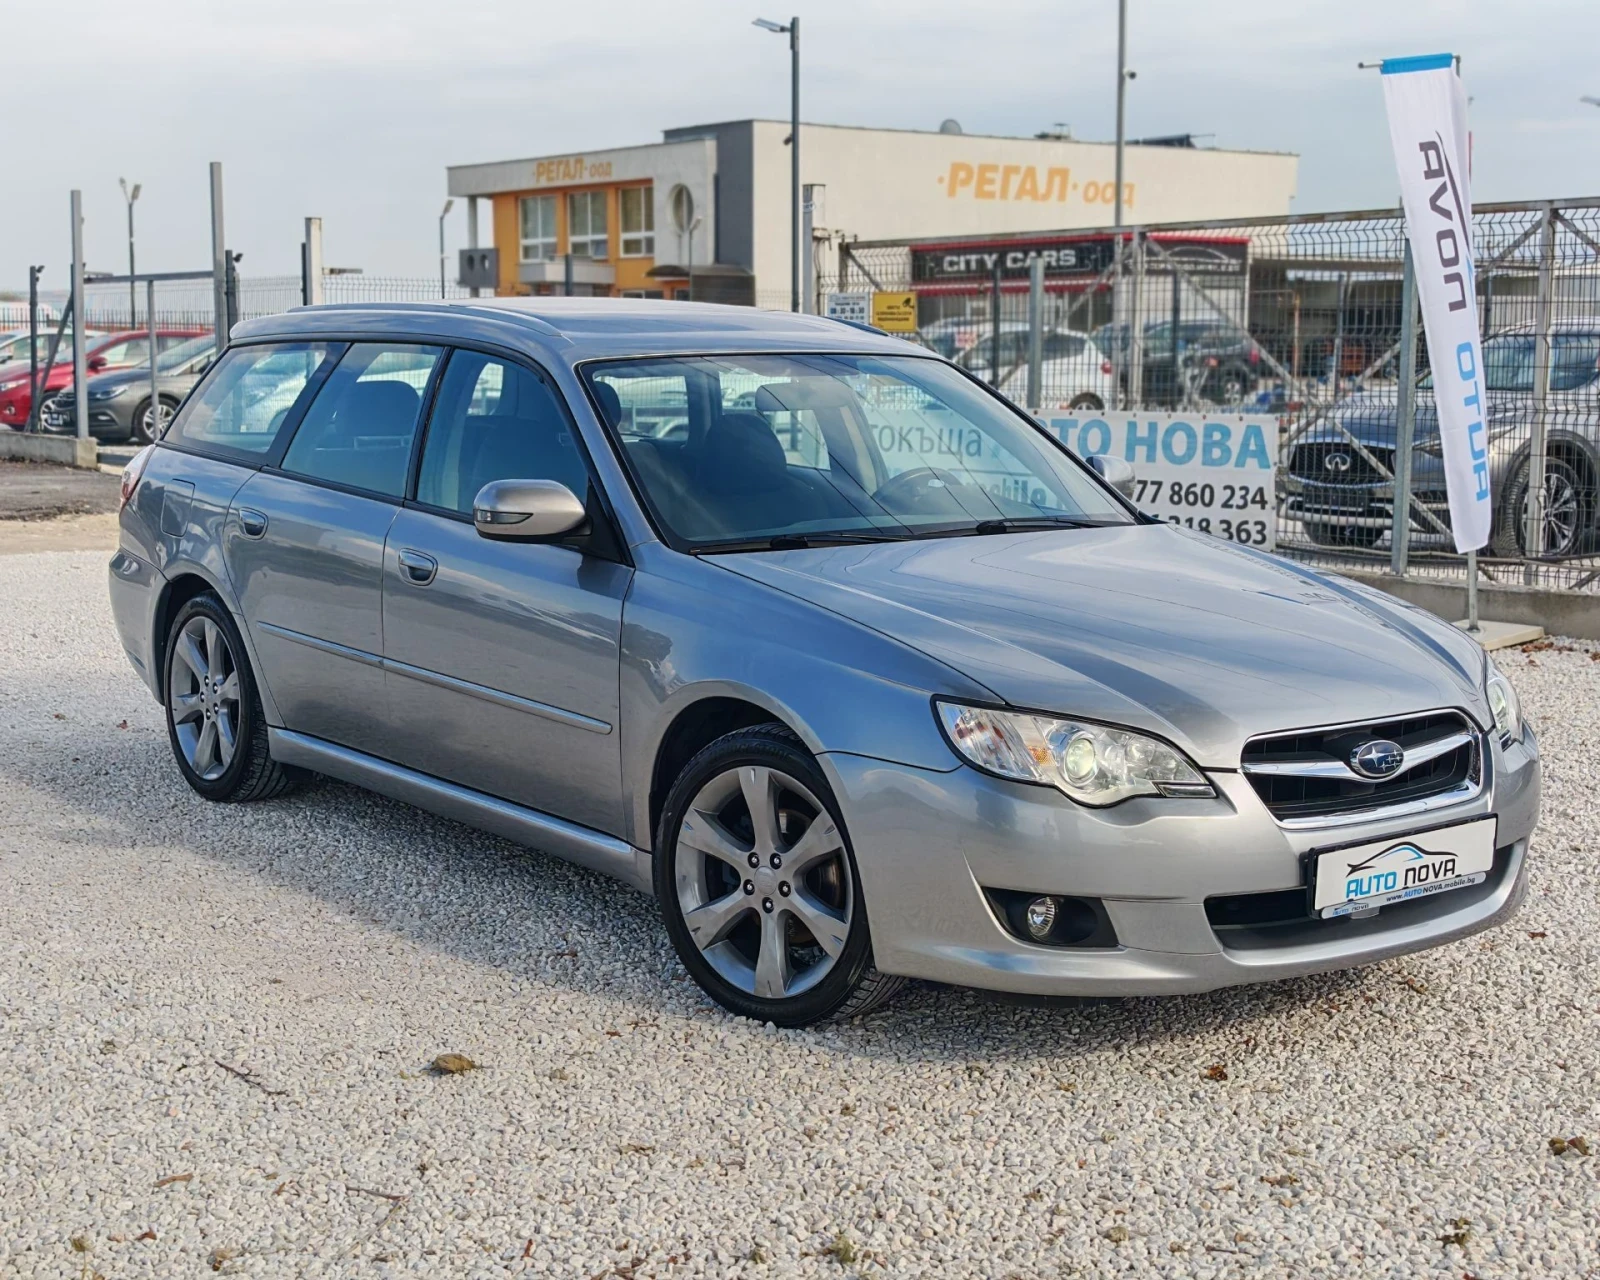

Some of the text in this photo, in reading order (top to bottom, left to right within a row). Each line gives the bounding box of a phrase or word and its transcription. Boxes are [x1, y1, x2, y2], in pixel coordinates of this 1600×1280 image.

[943, 252, 999, 272] CITY
[1124, 420, 1271, 470] НОВА
[1169, 482, 1215, 508] 860
[1220, 485, 1268, 511] 234
[1219, 519, 1268, 545] 363
[1346, 858, 1456, 899] AUTO NOVA
